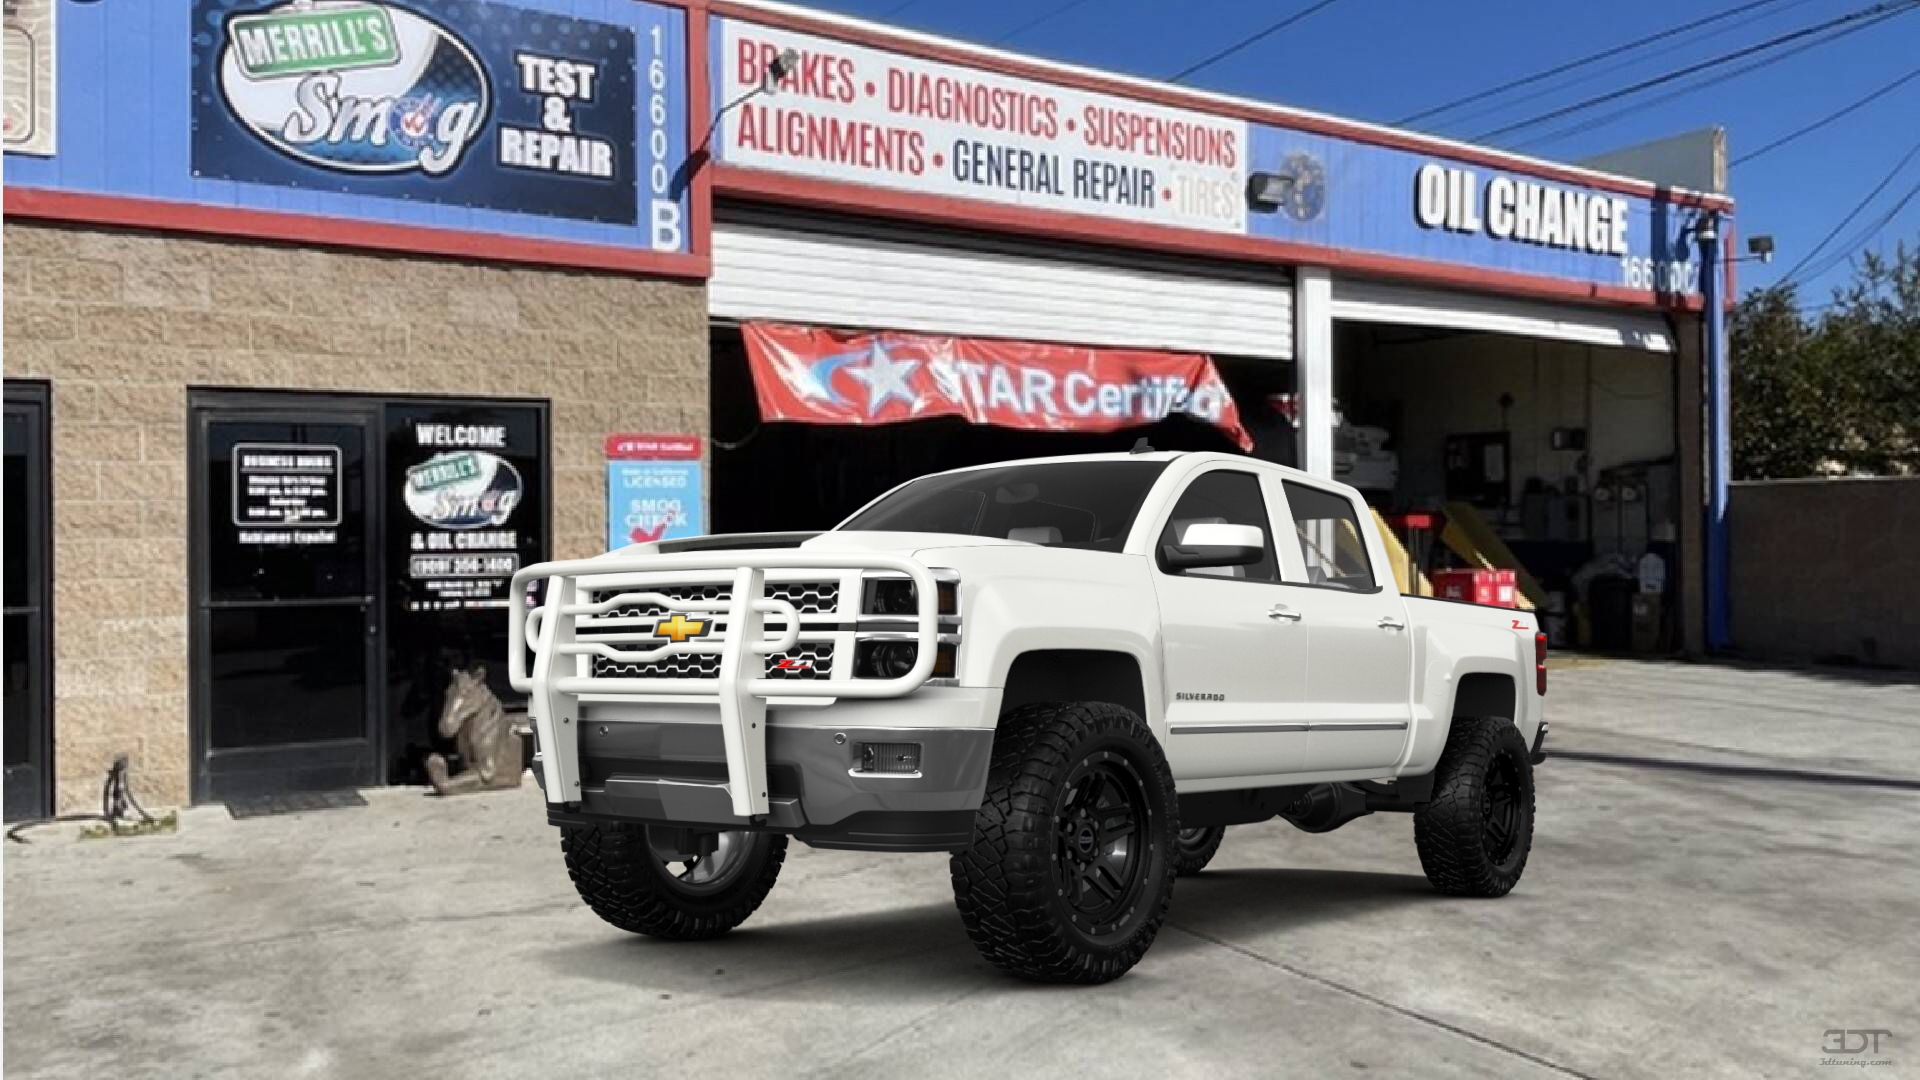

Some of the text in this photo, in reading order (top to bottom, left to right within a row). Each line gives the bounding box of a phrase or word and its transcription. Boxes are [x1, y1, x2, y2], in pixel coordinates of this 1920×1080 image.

[238, 16, 388, 67] MERRILL'S
[517, 53, 596, 99] TEST
[543, 95, 572, 132] &
[737, 38, 1236, 168] BRAKES DIAGNOSTICS SUSPENSIONS
[501, 126, 613, 176] REPAIR
[737, 102, 1235, 219] ALIGNMENTS GENERAL REPAIR TIRES
[1416, 164, 1629, 255] OIL CHANGE
[416, 423, 507, 446] WELCOME
[1176, 692, 1225, 701] SILVERADO
